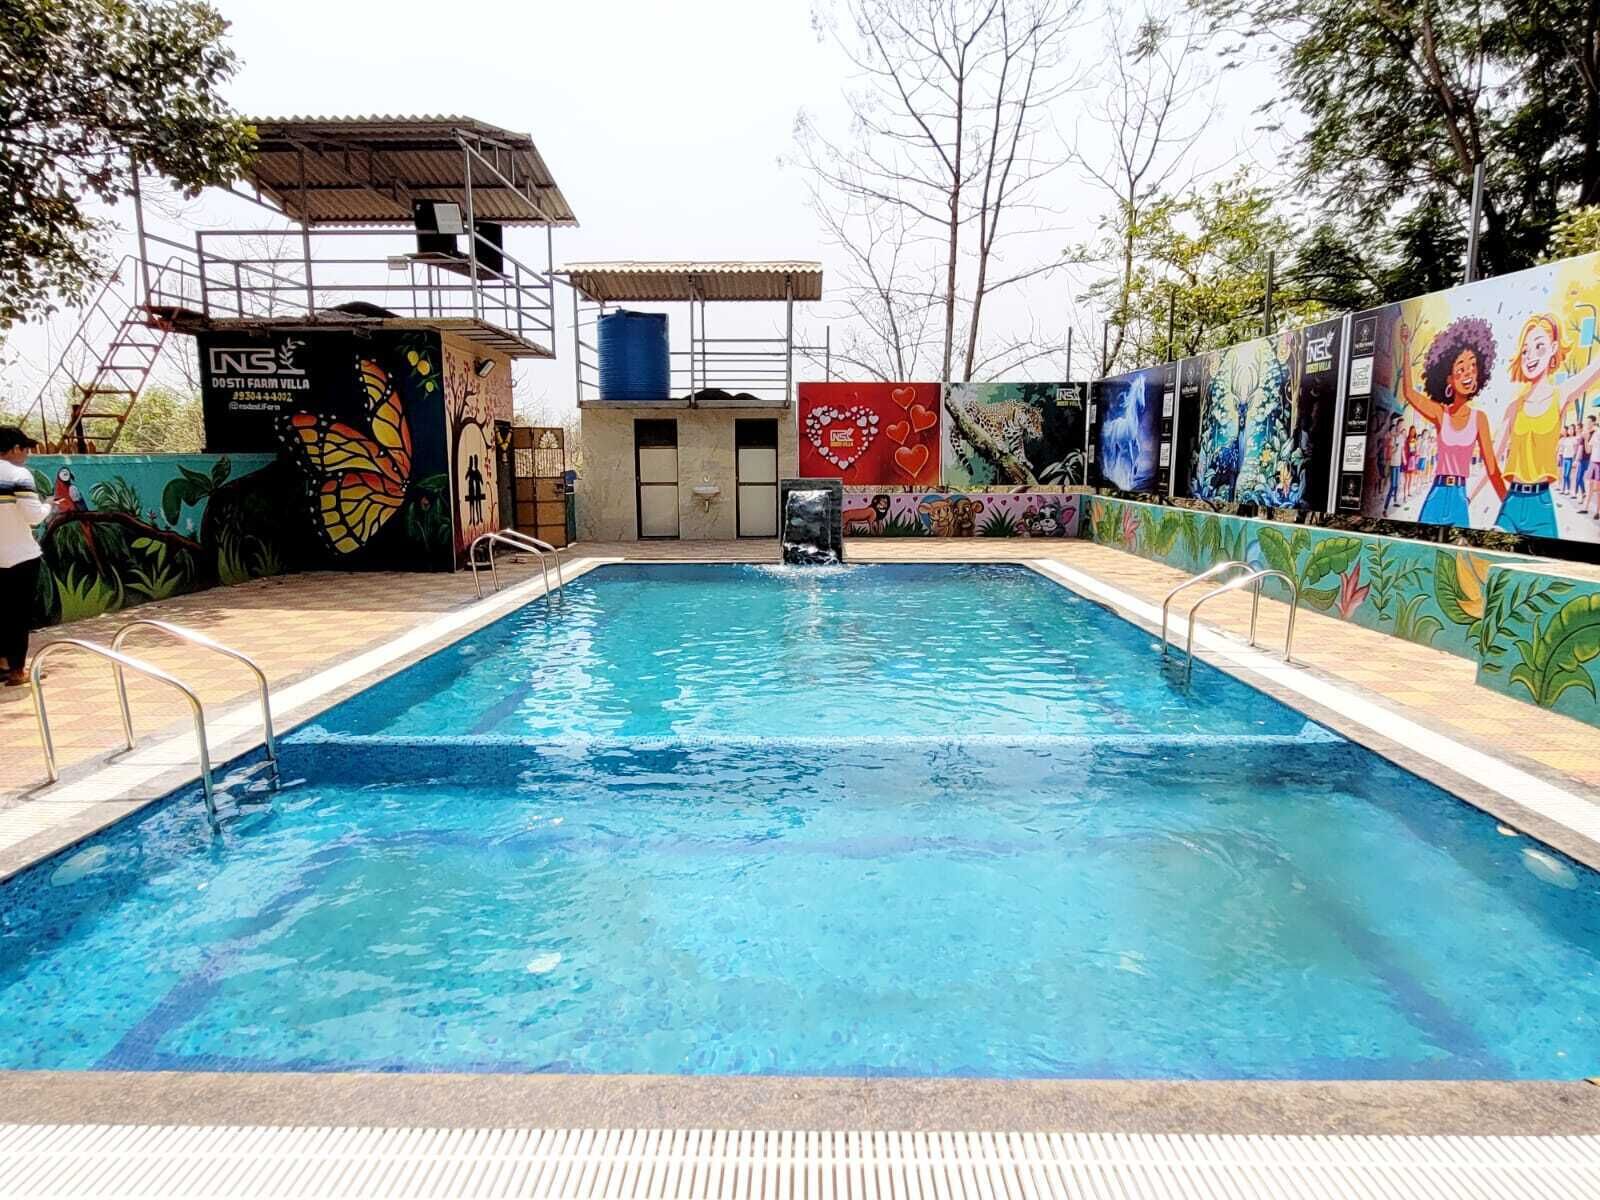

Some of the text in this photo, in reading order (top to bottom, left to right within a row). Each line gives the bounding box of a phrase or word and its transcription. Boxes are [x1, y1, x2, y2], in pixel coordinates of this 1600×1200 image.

[212, 377, 310, 390] DOSTI FARM VILLA
